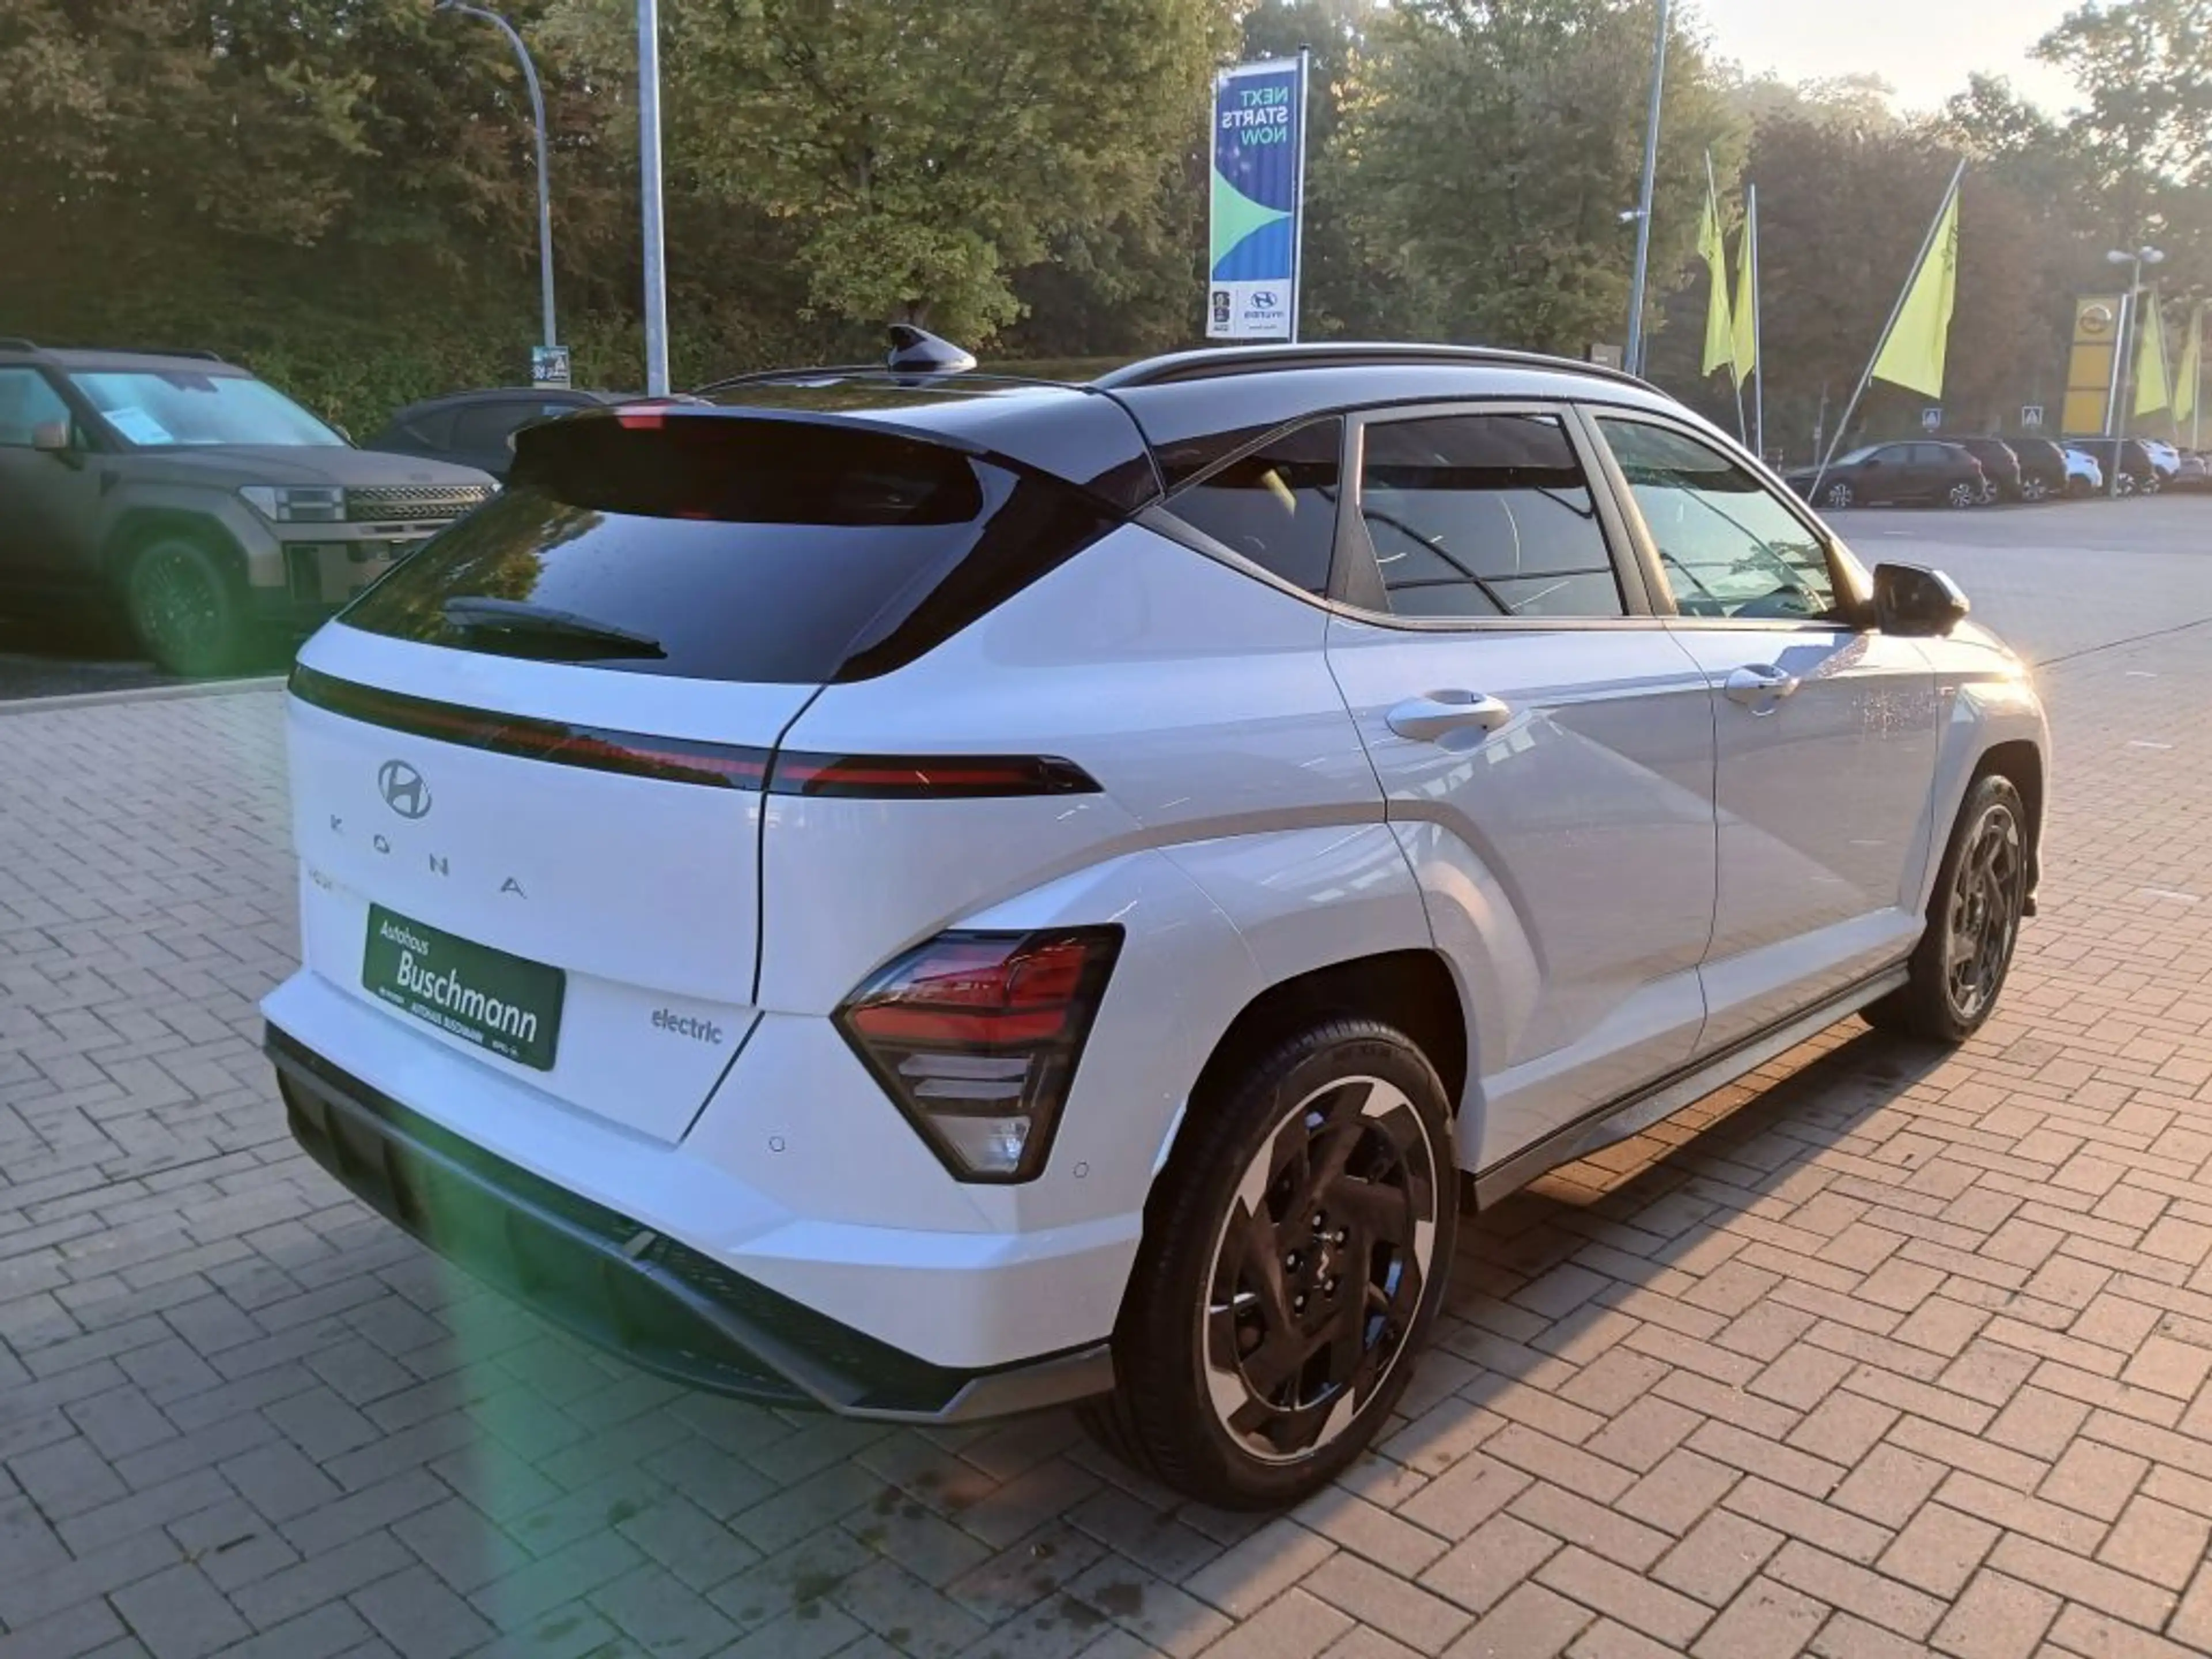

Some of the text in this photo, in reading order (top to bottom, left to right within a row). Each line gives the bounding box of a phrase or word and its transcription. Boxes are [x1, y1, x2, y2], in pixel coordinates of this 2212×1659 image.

[330, 814, 527, 900] KONA
[380, 919, 429, 956] Autohaus
[396, 949, 537, 1043] Buschmann
[652, 1007, 722, 1045] electric
